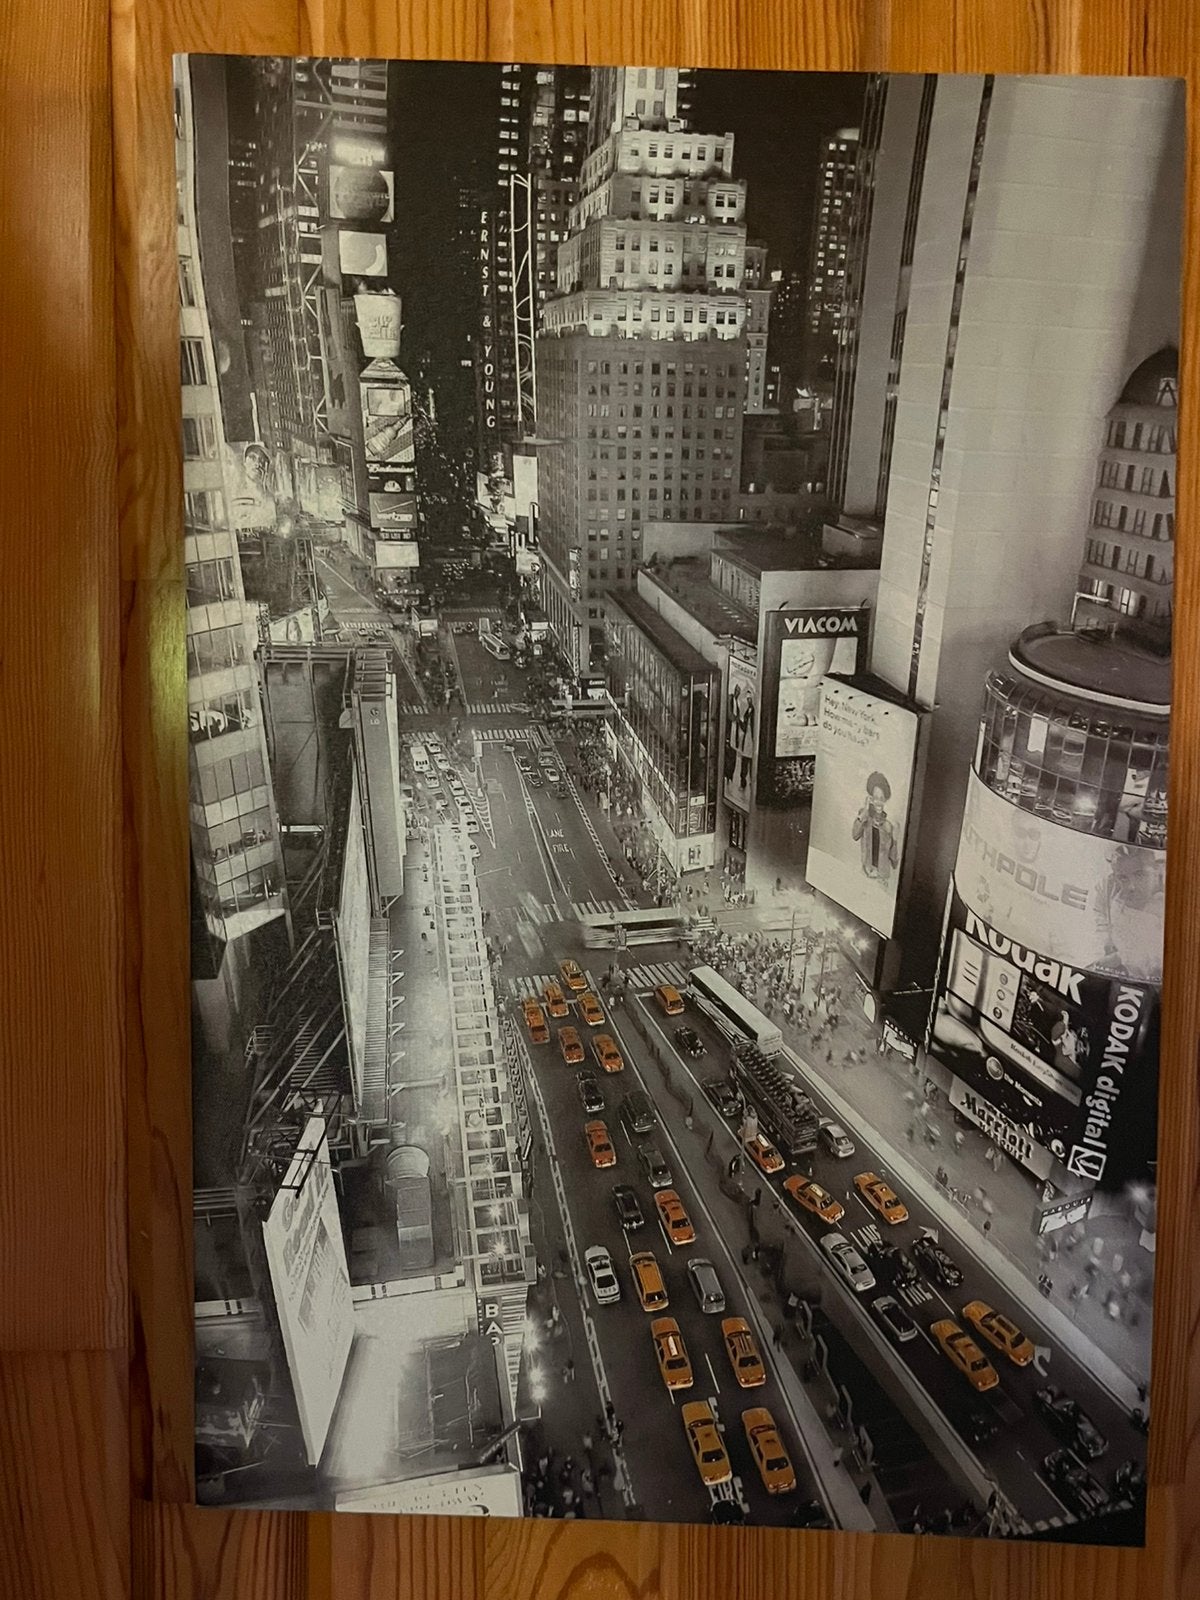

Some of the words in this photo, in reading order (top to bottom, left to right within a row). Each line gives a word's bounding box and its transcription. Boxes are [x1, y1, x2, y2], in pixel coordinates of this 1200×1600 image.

[480, 211, 489, 297] ERNST
[482, 315, 492, 328] &
[484, 345, 496, 428] YOUNG
[784, 616, 858, 634] VIACOM
[1100, 985, 1145, 1075] KODAK
[1083, 1075, 1121, 1149] digital
